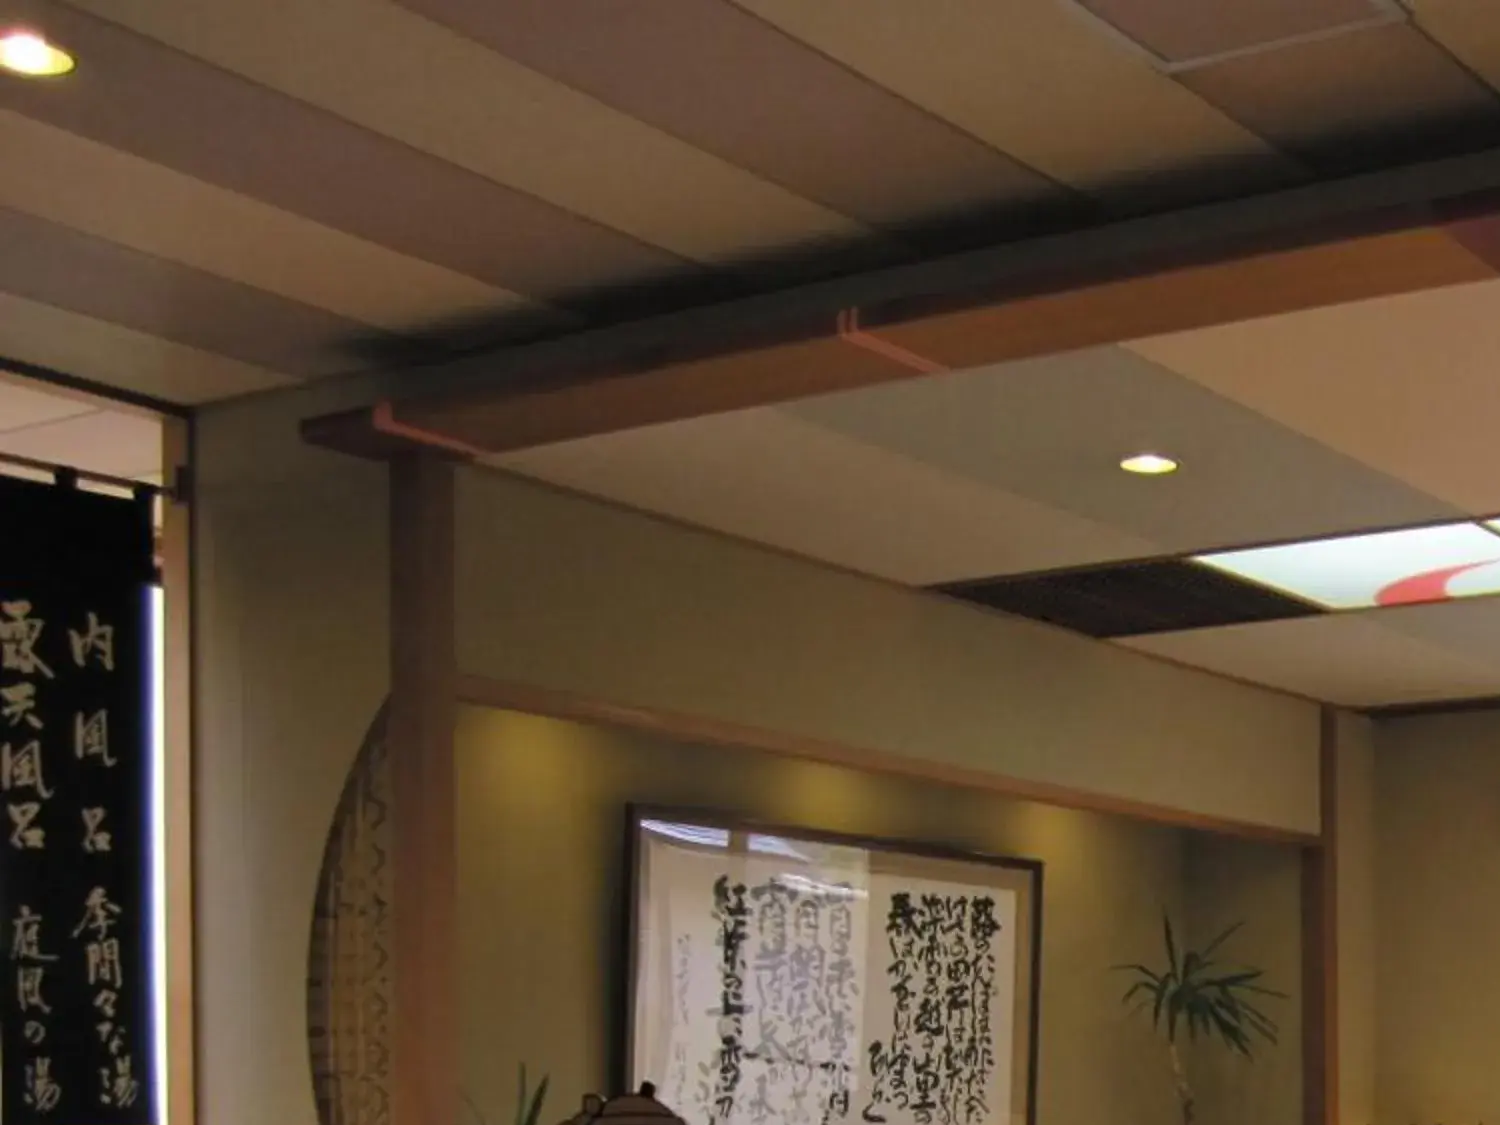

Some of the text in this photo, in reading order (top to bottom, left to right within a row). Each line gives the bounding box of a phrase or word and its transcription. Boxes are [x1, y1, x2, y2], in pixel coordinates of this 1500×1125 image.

[0, 599, 55, 849] 露天風呂
[68, 611, 117, 854] 内風呂
